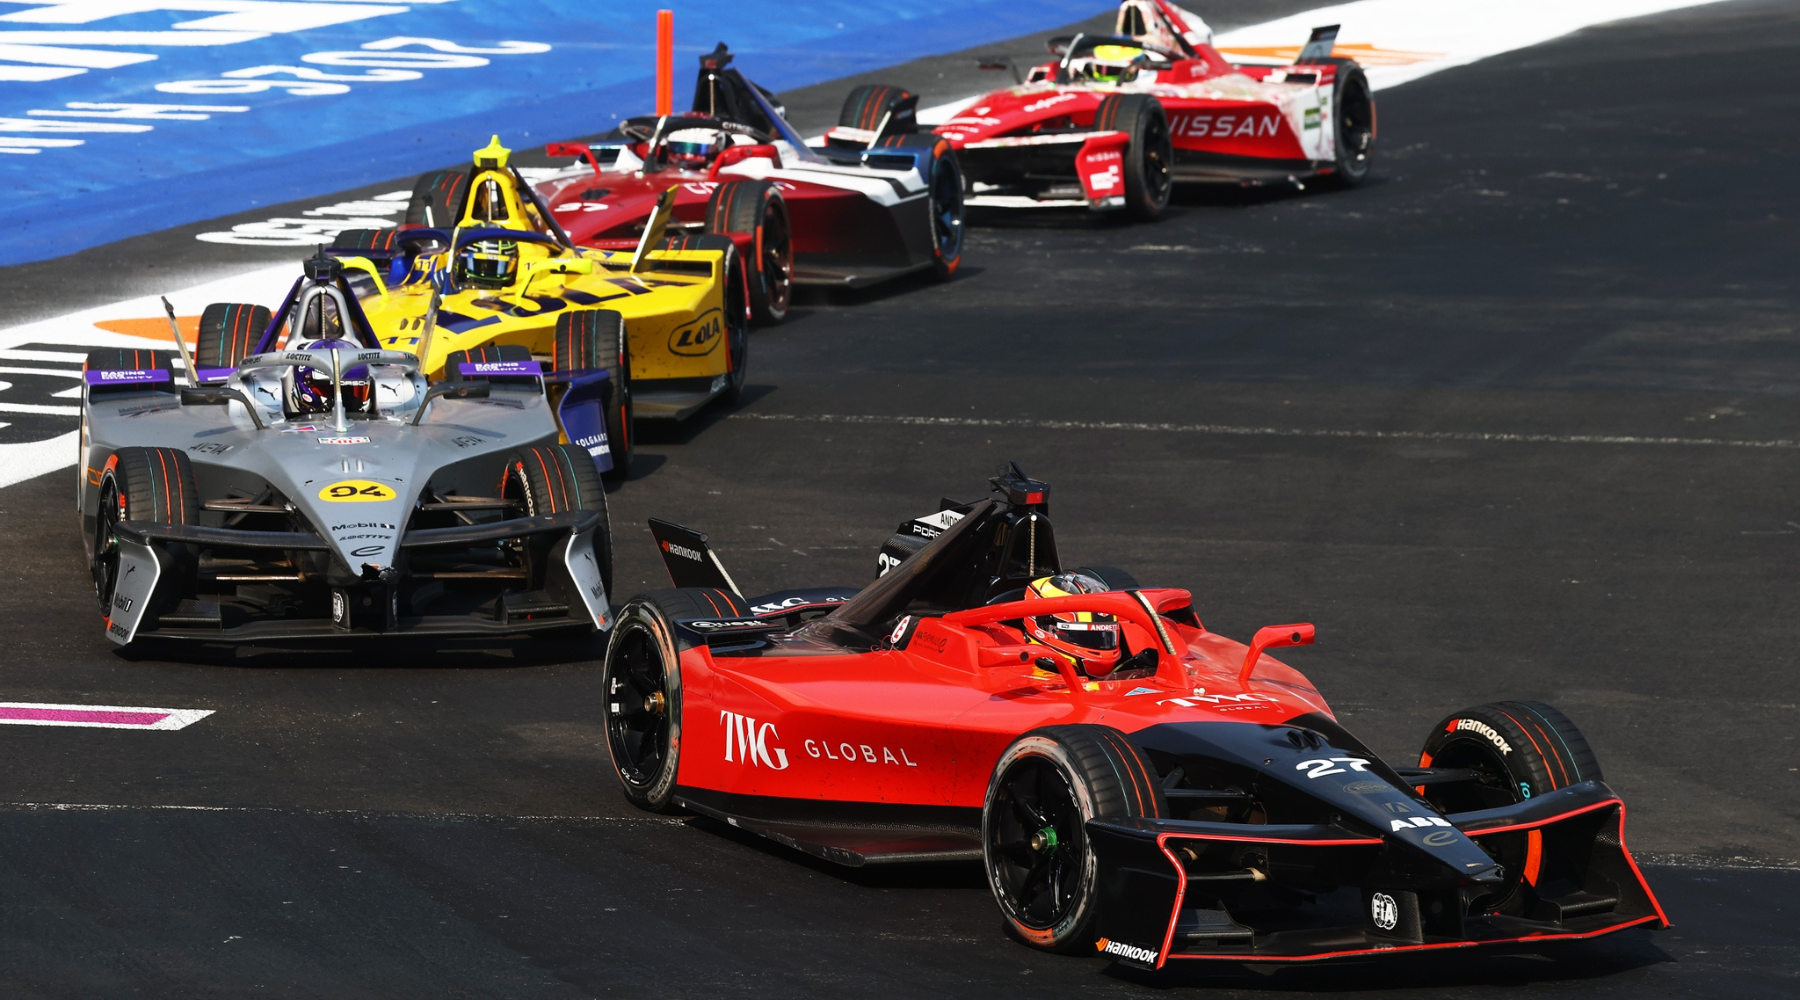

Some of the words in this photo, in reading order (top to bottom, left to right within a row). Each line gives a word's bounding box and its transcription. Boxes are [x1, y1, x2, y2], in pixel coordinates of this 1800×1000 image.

[676, 317, 720, 348] LOLA
[329, 485, 386, 498] 94
[720, 710, 789, 770] TWG
[804, 739, 918, 766] GLOBAL
[1296, 757, 1371, 779] 27
[1390, 816, 1452, 832] ABB
